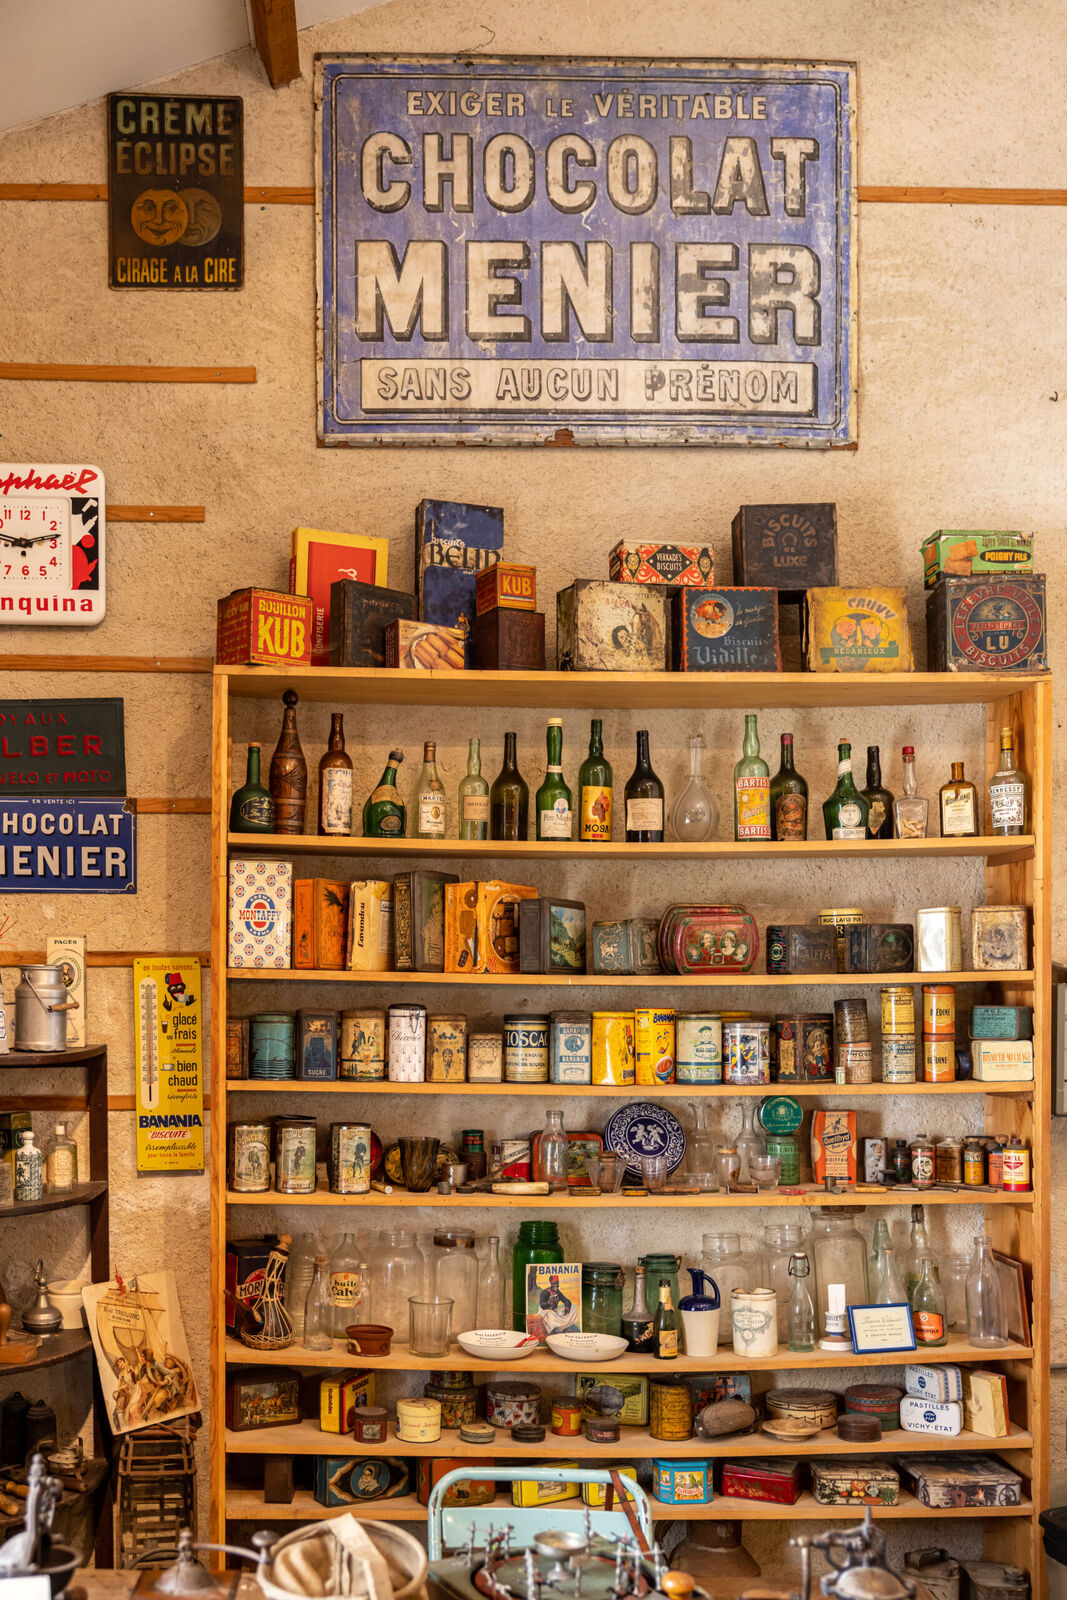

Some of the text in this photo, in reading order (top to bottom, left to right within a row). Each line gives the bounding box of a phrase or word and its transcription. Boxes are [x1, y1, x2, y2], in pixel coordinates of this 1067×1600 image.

[407, 88, 769, 120] EXIGER LE VÉRITABLE
[360, 131, 820, 217] CHOCOLAT
[117, 257, 168, 283] CIRAGE
[186, 265, 199, 283] LA
[204, 257, 237, 283] CIRE
[354, 239, 822, 346] MENIER
[377, 364, 799, 404] SANS AUCUN PRÉNOM
[4, 509, 46, 521] 11 12 1
[50, 520, 57, 531] 2
[762, 513, 818, 549] BISCUITS
[50, 539, 57, 549] 3
[49, 557, 58, 567] 4
[656, 562, 683, 571] BISCUITS
[773, 555, 808, 567] LUXE
[4, 565, 47, 576] 7 6 5
[502, 575, 532, 596] KUB
[258, 599, 306, 619] BOUILLON
[847, 596, 898, 621] CAUVY
[258, 614, 306, 658] KUB
[965, 644, 1029, 666] BISCUITS
[46, 773, 59, 784] ET
[63, 770, 112, 784] MOTO
[0, 844, 128, 877] ENIER
[239, 910, 281, 921] MONTAFFY
[173, 1011, 198, 1027] glacé
[174, 1027, 197, 1040] frais
[176, 1060, 198, 1072] bien
[168, 1074, 198, 1087] chaud
[138, 1114, 203, 1128] BANANIA
[538, 1265, 580, 1275] BANANIA
[909, 1401, 950, 1411] PASTILLES
